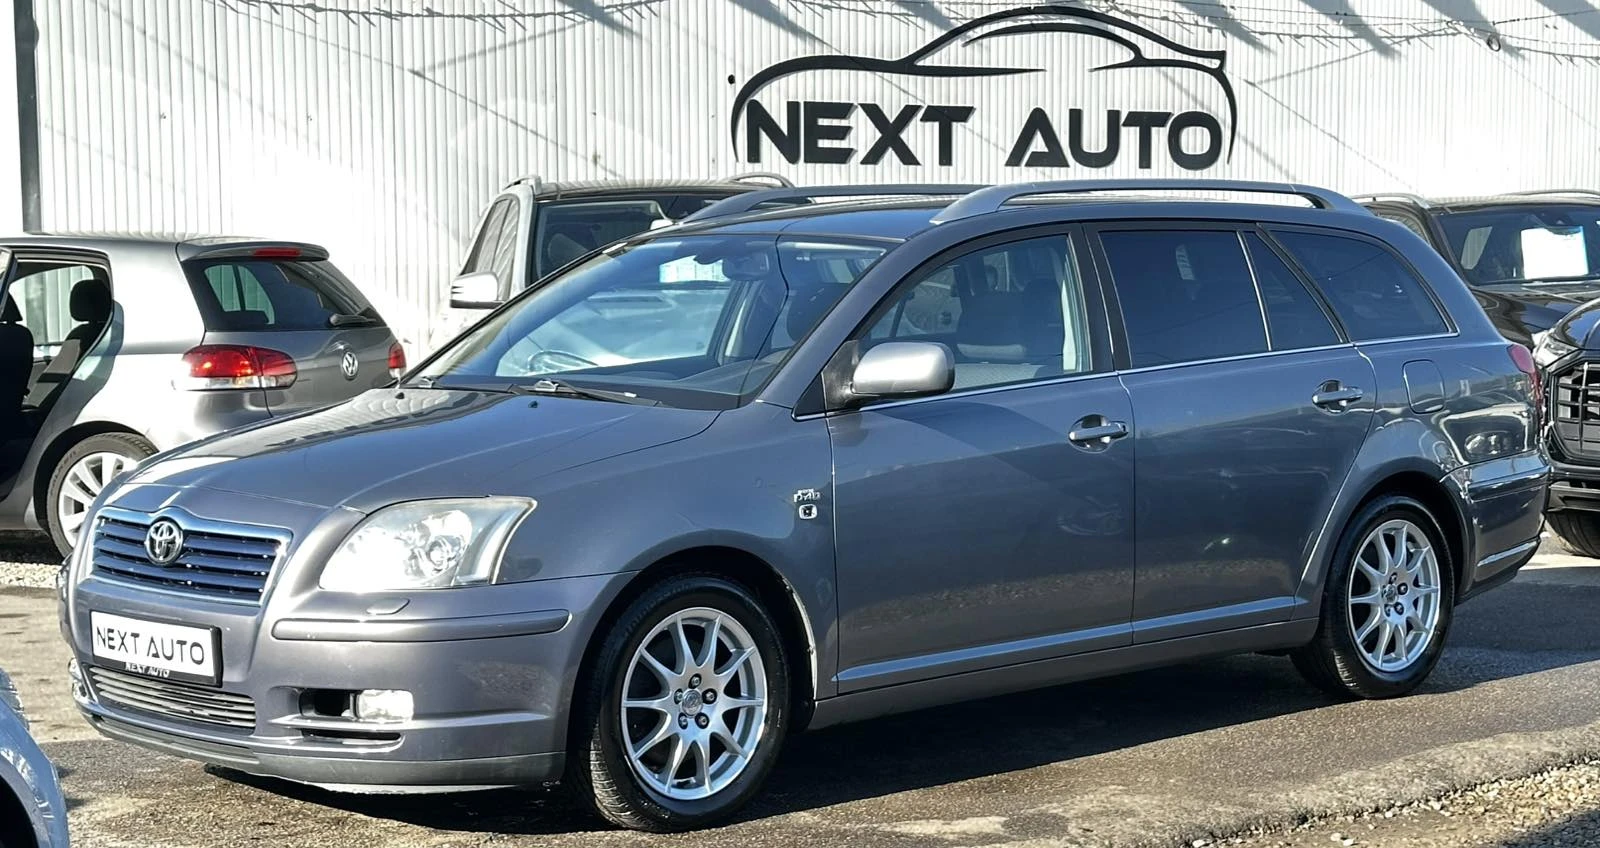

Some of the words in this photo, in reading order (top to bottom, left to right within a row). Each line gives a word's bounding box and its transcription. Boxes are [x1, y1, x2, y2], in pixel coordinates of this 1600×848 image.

[746, 99, 974, 166] NEXT
[1005, 107, 1222, 170] AUTO
[96, 626, 140, 654] NEXT
[147, 636, 205, 665] AUTO
